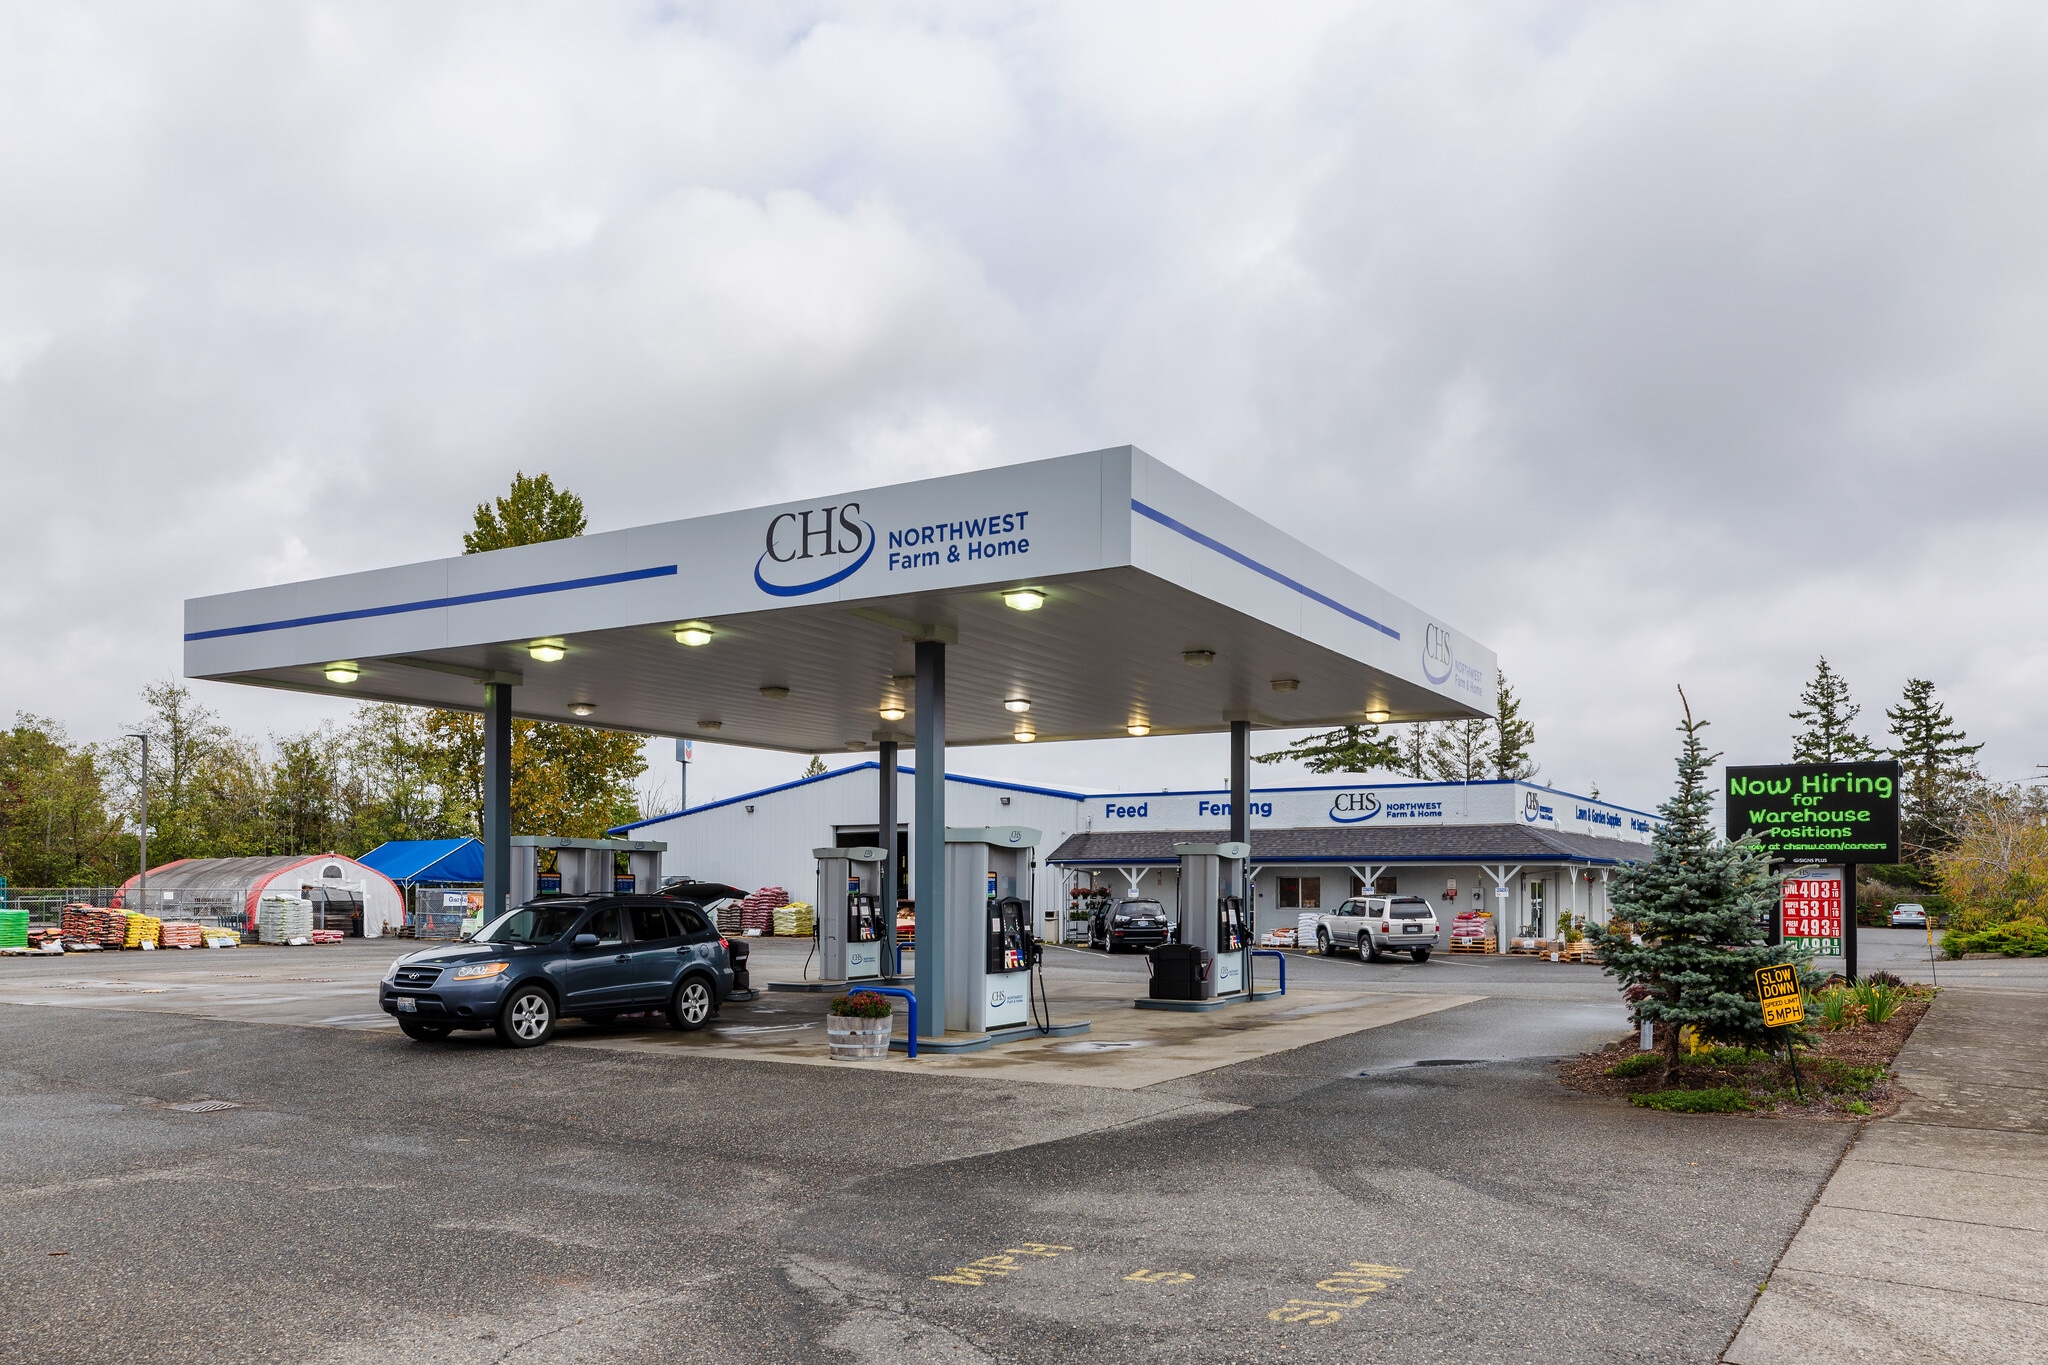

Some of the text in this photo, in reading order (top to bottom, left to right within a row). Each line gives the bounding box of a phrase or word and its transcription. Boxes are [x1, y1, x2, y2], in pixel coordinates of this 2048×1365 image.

[766, 502, 863, 563] CHS
[888, 511, 1029, 549] NORTHWEST
[888, 538, 1030, 571] Farm & Home
[1425, 622, 1450, 666] CHS
[1455, 659, 1482, 683] NORTHWEST
[1455, 673, 1465, 689] Farm
[1470, 681, 1483, 696] Home
[1730, 772, 1893, 798] Now Hiring
[1335, 792, 1377, 812] CHS
[1386, 802, 1442, 811] NORTHWEST
[1791, 793, 1823, 806] for
[1105, 800, 1272, 818] Feed Fenng
[1418, 809, 1442, 817] Home
[1575, 805, 1587, 821] Lawn
[1592, 809, 1606, 825] Garden
[1749, 808, 1871, 824] Warehouse
[1771, 825, 1852, 838] Positions
[1768, 842, 1780, 850] at
[1783, 842, 1887, 852] chsnw.com/careers
[1800, 882, 1830, 898] 403
[1800, 901, 1829, 917] 531
[1800, 919, 1830, 936] 493
[1761, 968, 1791, 985] SLOW
[992, 991, 1004, 1001] CHS
[1763, 981, 1795, 998] DOWN
[1765, 997, 1798, 1008] SPEED LIMIT
[1768, 1006, 1800, 1021] 5 MPH
[929, 1242, 1073, 1286] MPH
[1122, 1268, 1195, 1284] 5
[1267, 1261, 1413, 1326] SLOW
